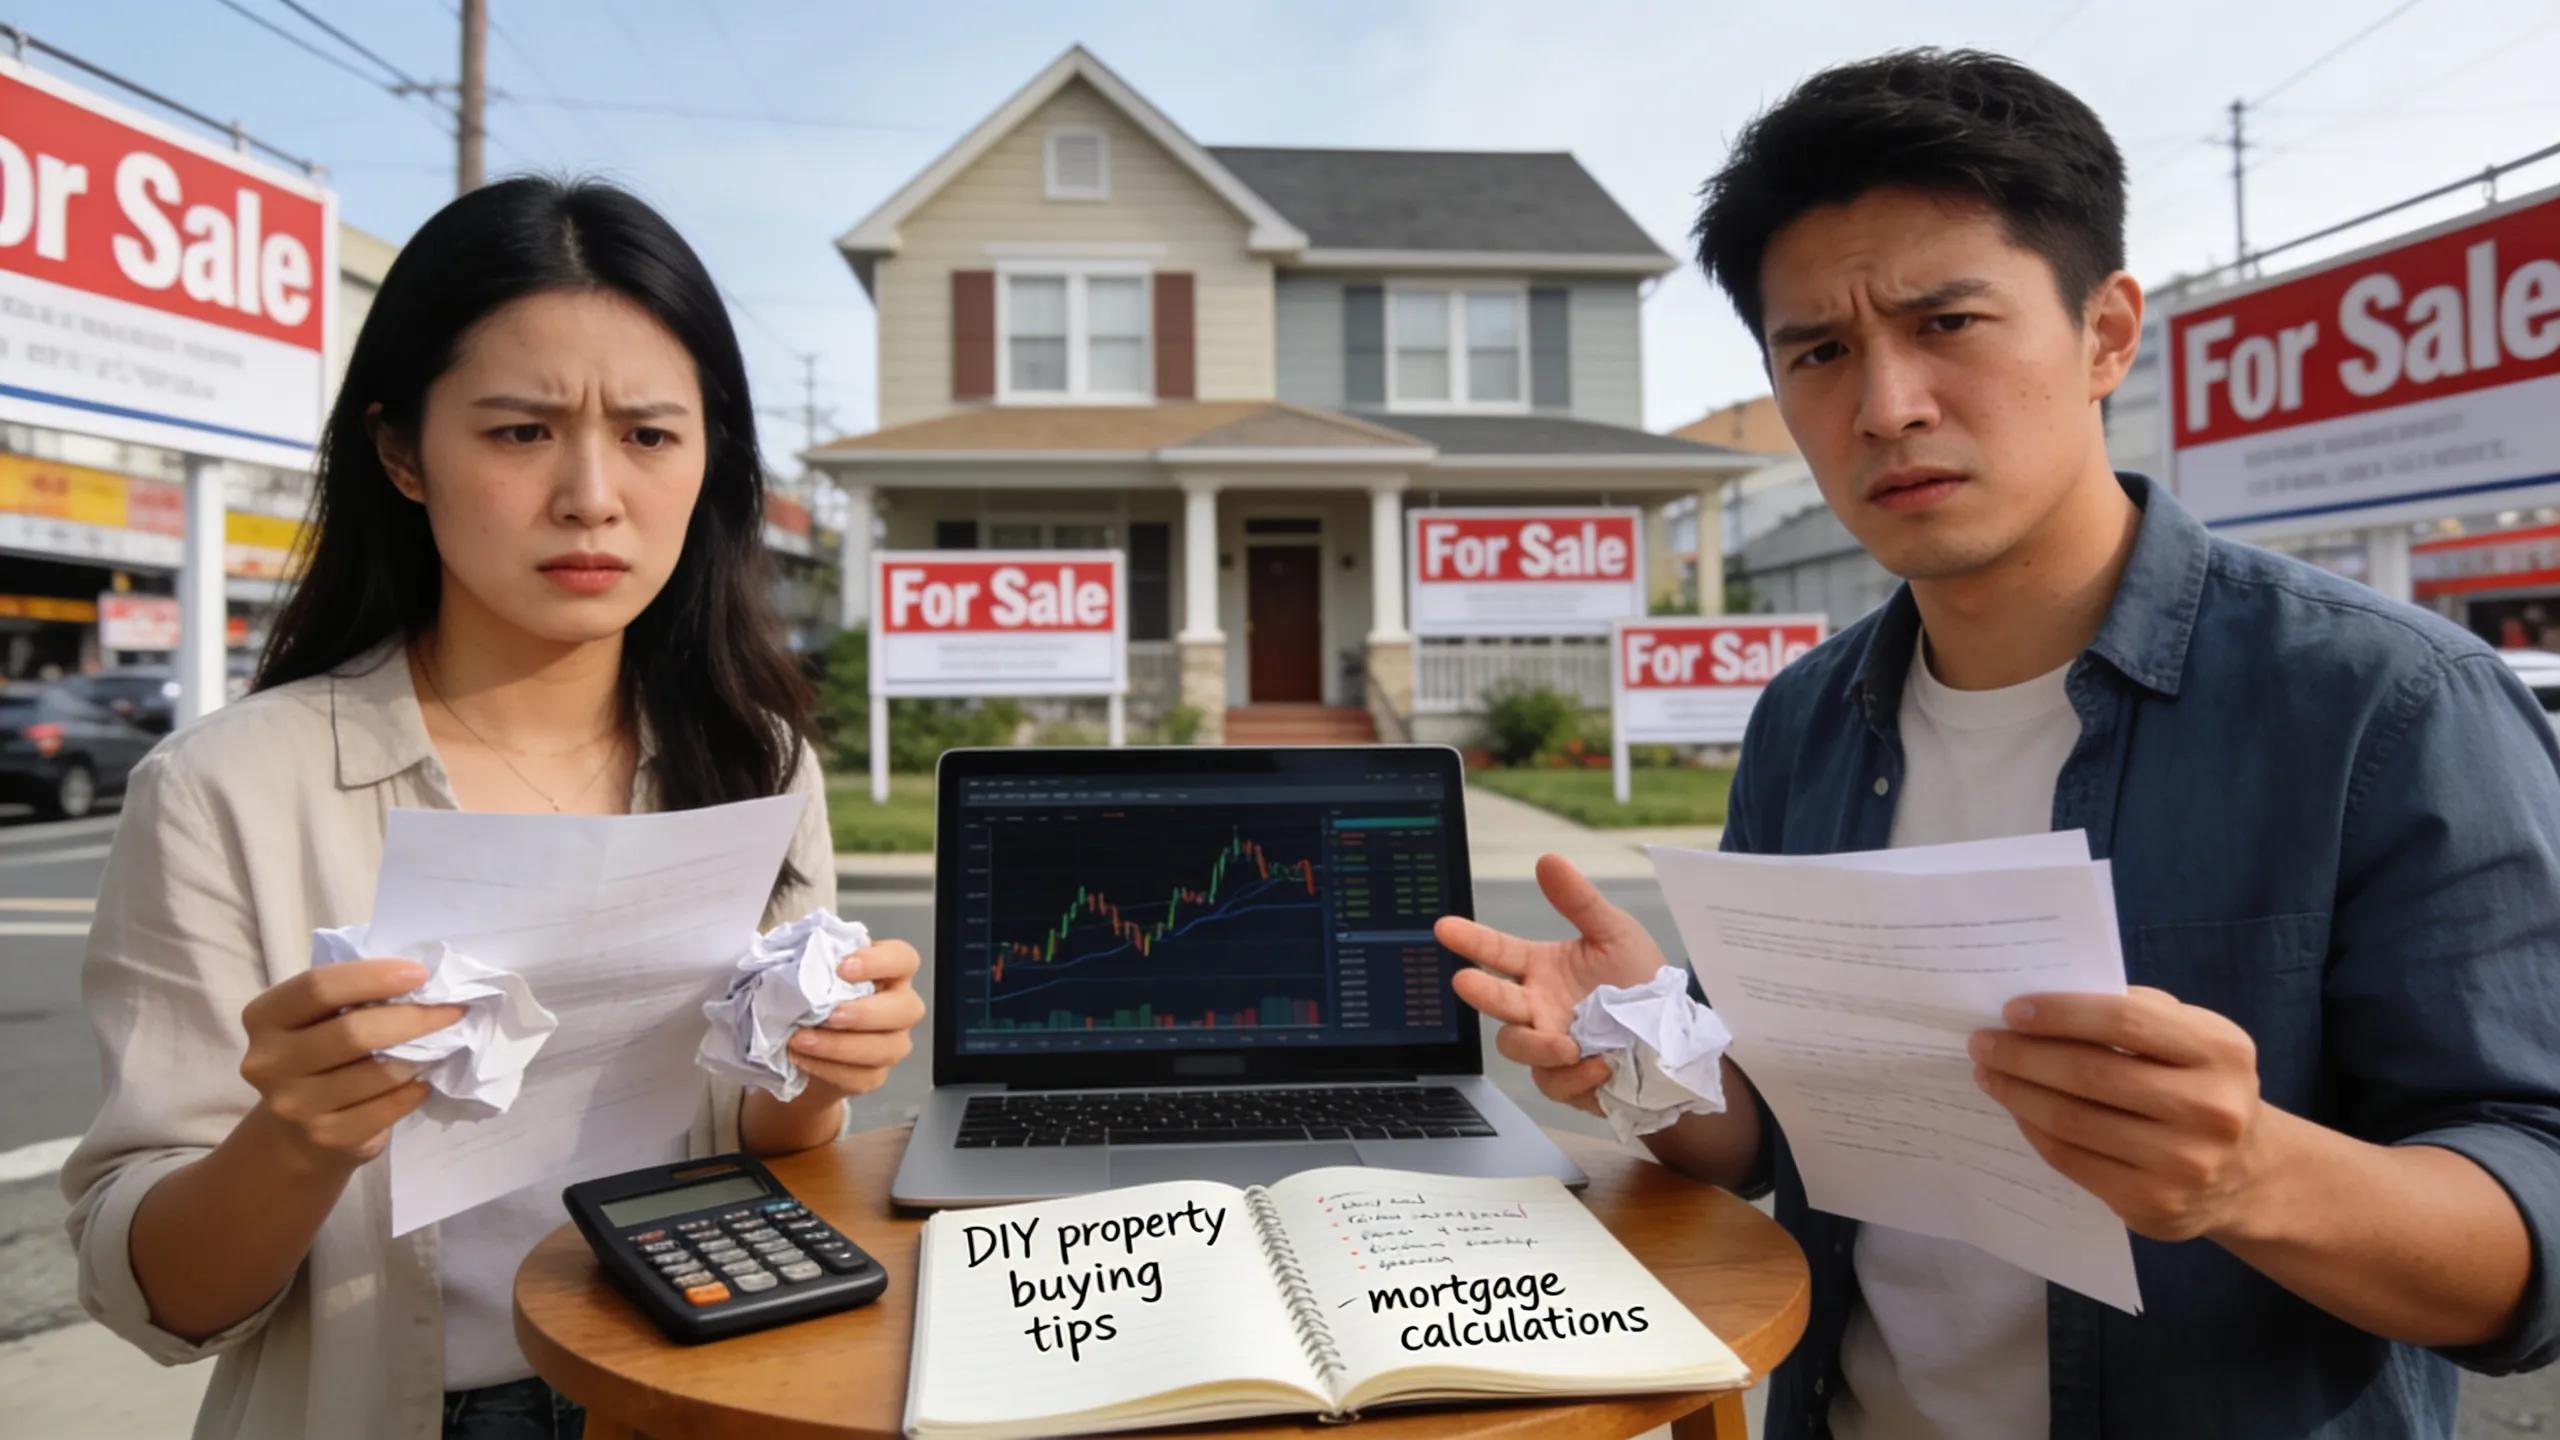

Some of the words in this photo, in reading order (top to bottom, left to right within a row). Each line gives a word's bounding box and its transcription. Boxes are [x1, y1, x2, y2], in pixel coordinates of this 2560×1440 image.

[111, 151, 312, 326] Sale
[2184, 314, 2319, 433] For
[2338, 239, 2560, 396] Sale
[1426, 524, 1509, 577] For
[1519, 523, 1627, 577] Sale
[890, 568, 980, 627] For
[990, 567, 1109, 626] Sale
[1626, 634, 1702, 683] For
[963, 1217, 1039, 1267] DIY
[1058, 1200, 1226, 1265] property
[1010, 1262, 1162, 1310] buying
[1368, 1272, 1566, 1315] mortgage
[1024, 1315, 1117, 1362] tips
[1401, 1306, 1649, 1351] calculations
